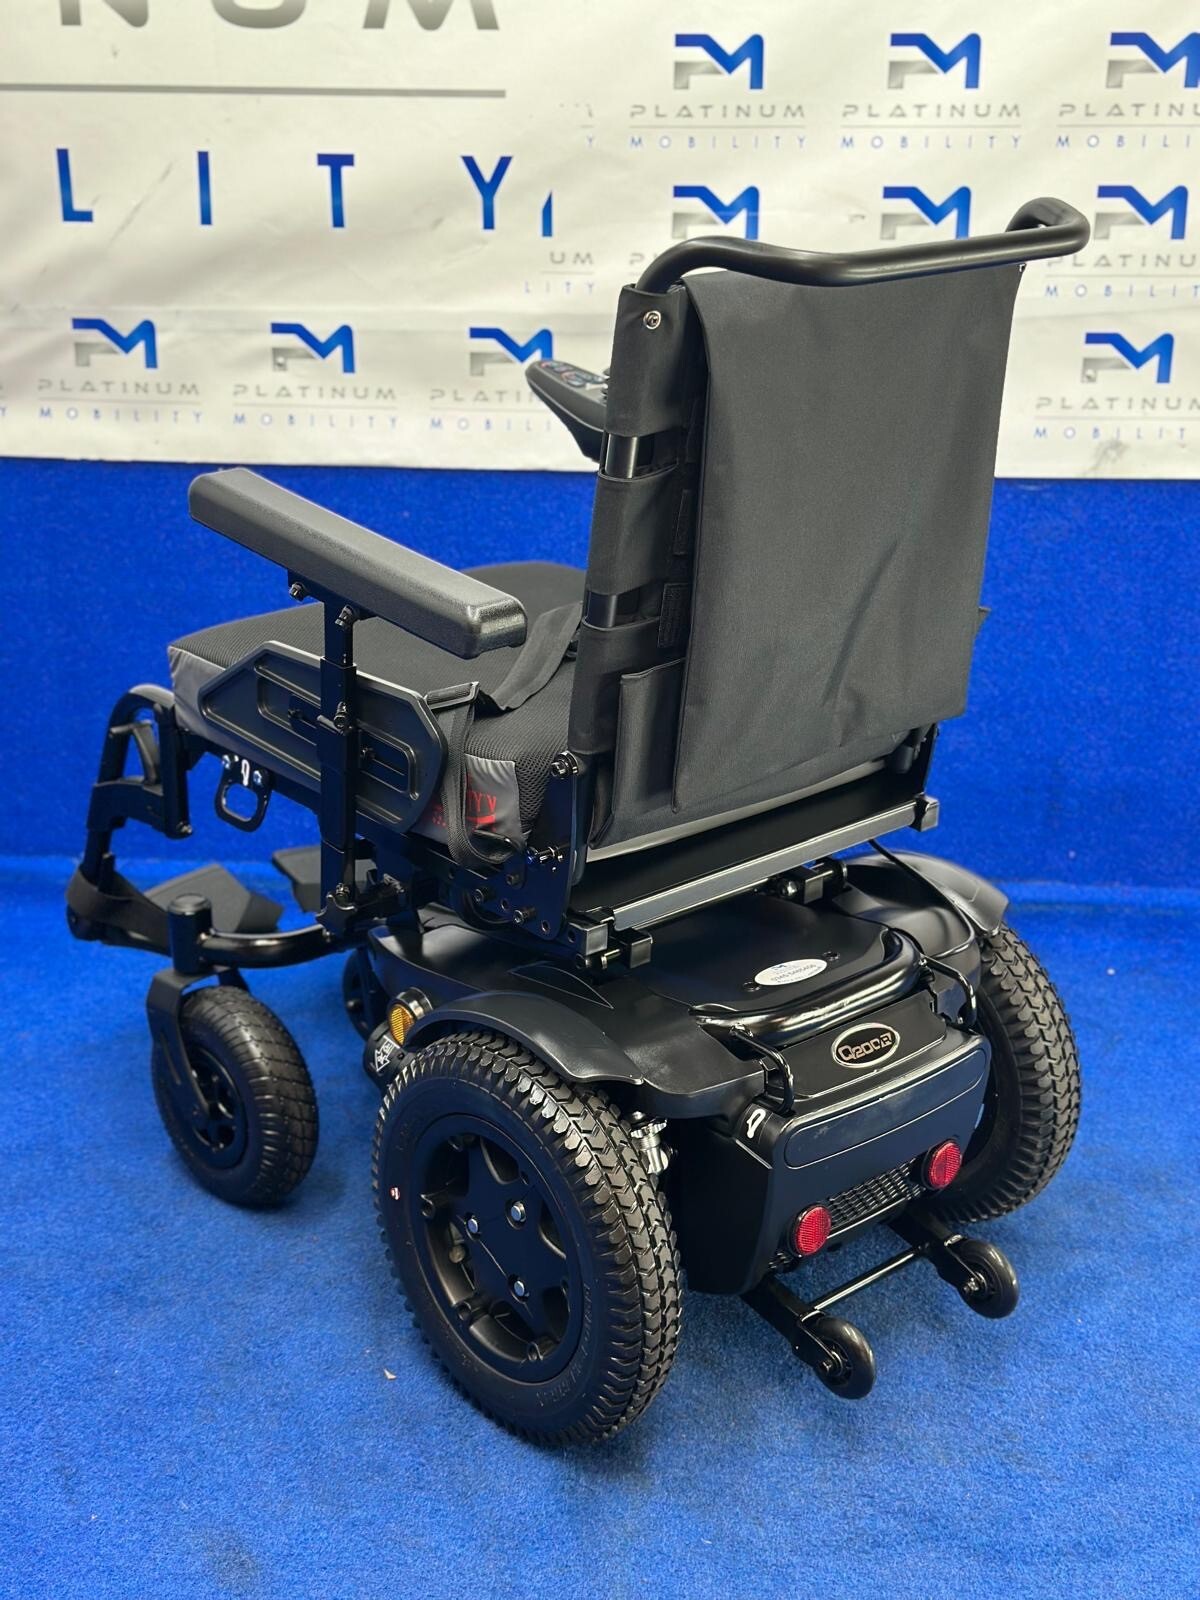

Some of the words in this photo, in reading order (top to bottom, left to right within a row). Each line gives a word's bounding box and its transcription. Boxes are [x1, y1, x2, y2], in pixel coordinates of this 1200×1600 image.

[630, 104, 805, 118] PLATINUM
[842, 104, 1021, 118] PLATINUM
[630, 135, 805, 149] MOBILITY
[841, 135, 1021, 149] MOBILITY
[1056, 135, 1190, 149] MOBILI
[550, 251, 594, 265] UM
[37, 379, 200, 396] PLATINUM
[233, 384, 395, 400] PLATINUM
[38, 407, 202, 423] MOBILITY
[233, 412, 397, 428] MOBILITY
[1034, 427, 1187, 440] MOBILIT
[838, 1032, 892, 1061] Q200R
